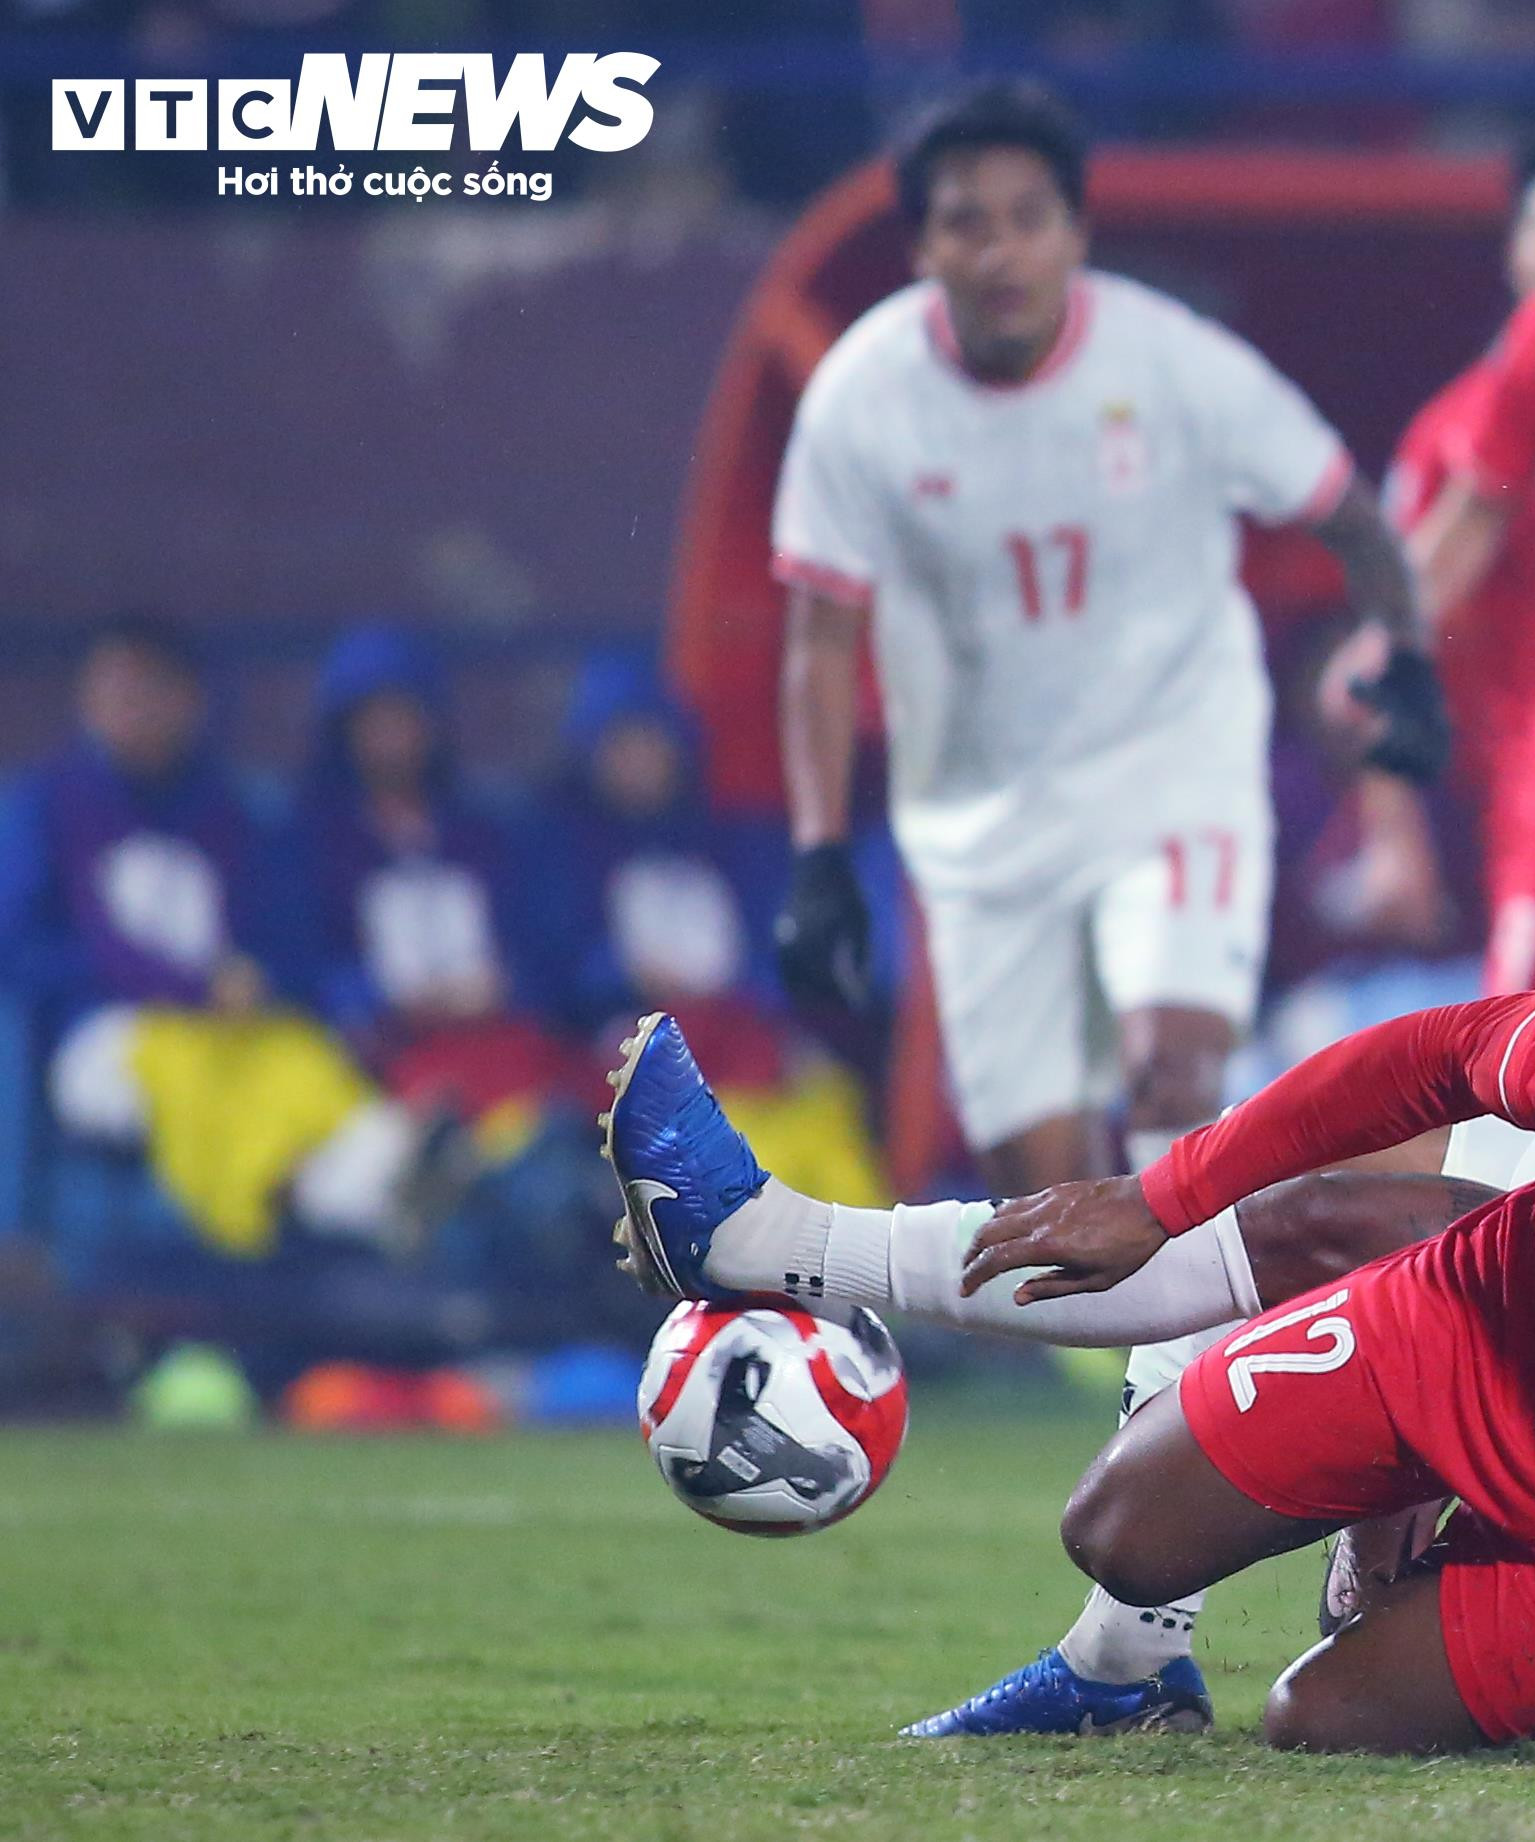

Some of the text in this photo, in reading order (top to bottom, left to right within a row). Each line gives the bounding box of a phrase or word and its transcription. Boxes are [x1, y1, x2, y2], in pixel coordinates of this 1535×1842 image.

[1005, 525, 1091, 622] 17
[1160, 826, 1238, 907] 17
[1223, 1287, 1357, 1414] 12
